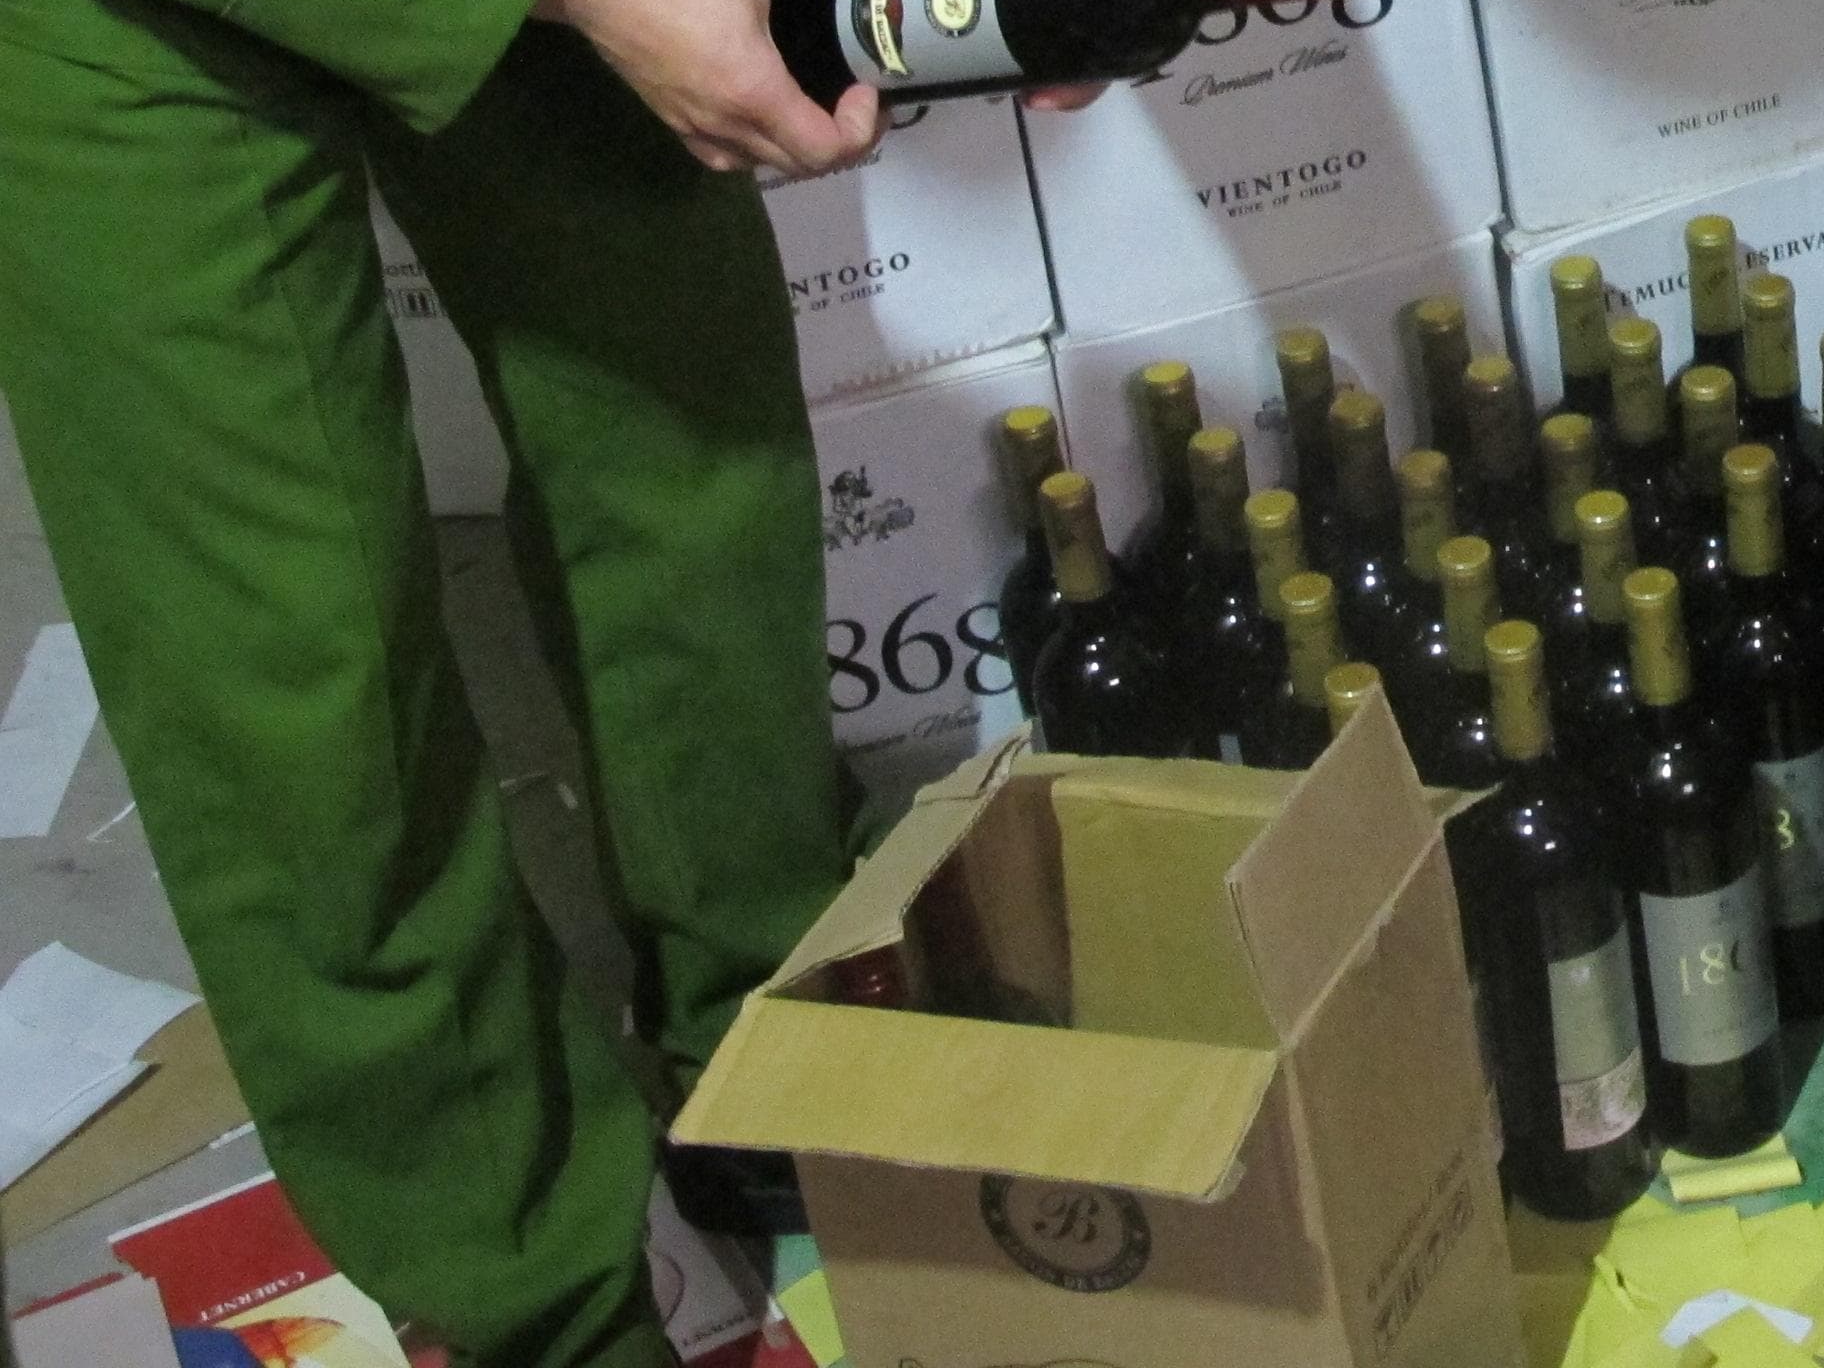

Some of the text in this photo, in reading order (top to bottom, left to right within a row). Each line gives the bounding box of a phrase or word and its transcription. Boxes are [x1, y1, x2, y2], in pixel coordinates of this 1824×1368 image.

[1179, 38, 1349, 107] Premium Wines
[1658, 93, 1781, 138] WINE OF CHILE
[1196, 149, 1368, 209] VIENTOGO
[1227, 181, 1344, 219] WINE OF CHILE
[790, 252, 911, 300] NTOGO
[811, 282, 886, 312] OF CHILE
[1603, 272, 1692, 313] TEMUC
[826, 591, 1019, 714] 868
[200, 1271, 306, 1322] CABERNET
